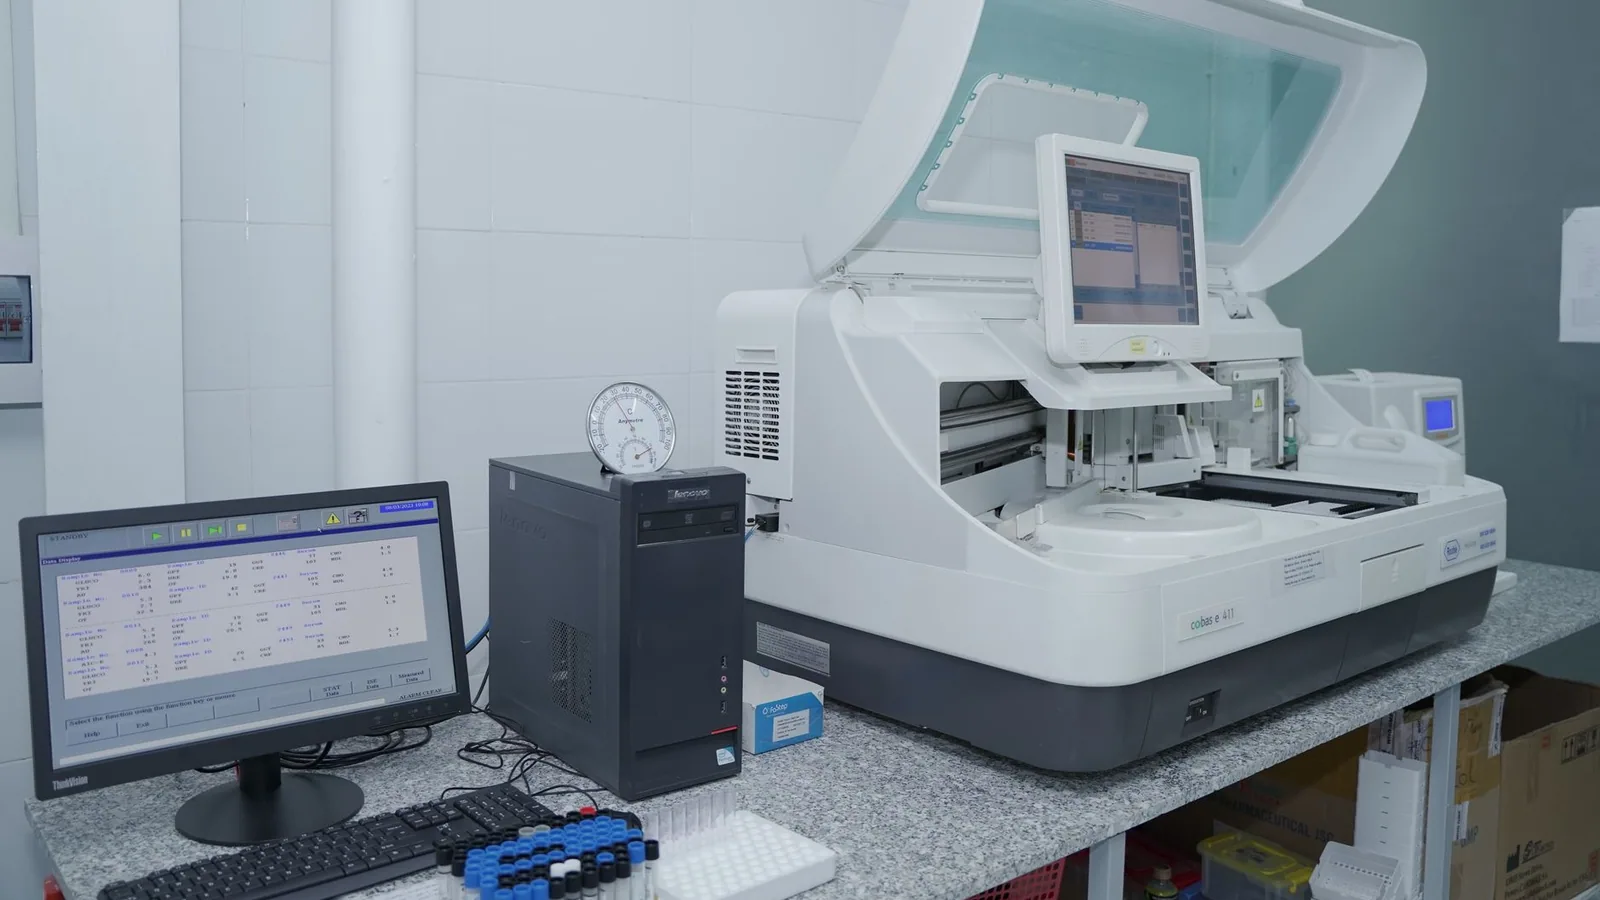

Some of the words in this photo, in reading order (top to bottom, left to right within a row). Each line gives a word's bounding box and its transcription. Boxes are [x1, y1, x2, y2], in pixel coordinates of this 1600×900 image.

[601, 395, 607, 404] 20
[656, 402, 663, 410] 70
[662, 414, 668, 422] 80
[50, 533, 88, 541] STANDBY
[1191, 616, 1212, 630] cobas
[1215, 614, 1219, 623] e
[1223, 608, 1234, 620] 411
[69, 718, 91, 727] Select
[106, 710, 133, 720] function
[134, 707, 152, 716] using
[166, 700, 192, 710] function
[53, 775, 88, 791] ThinkVision
